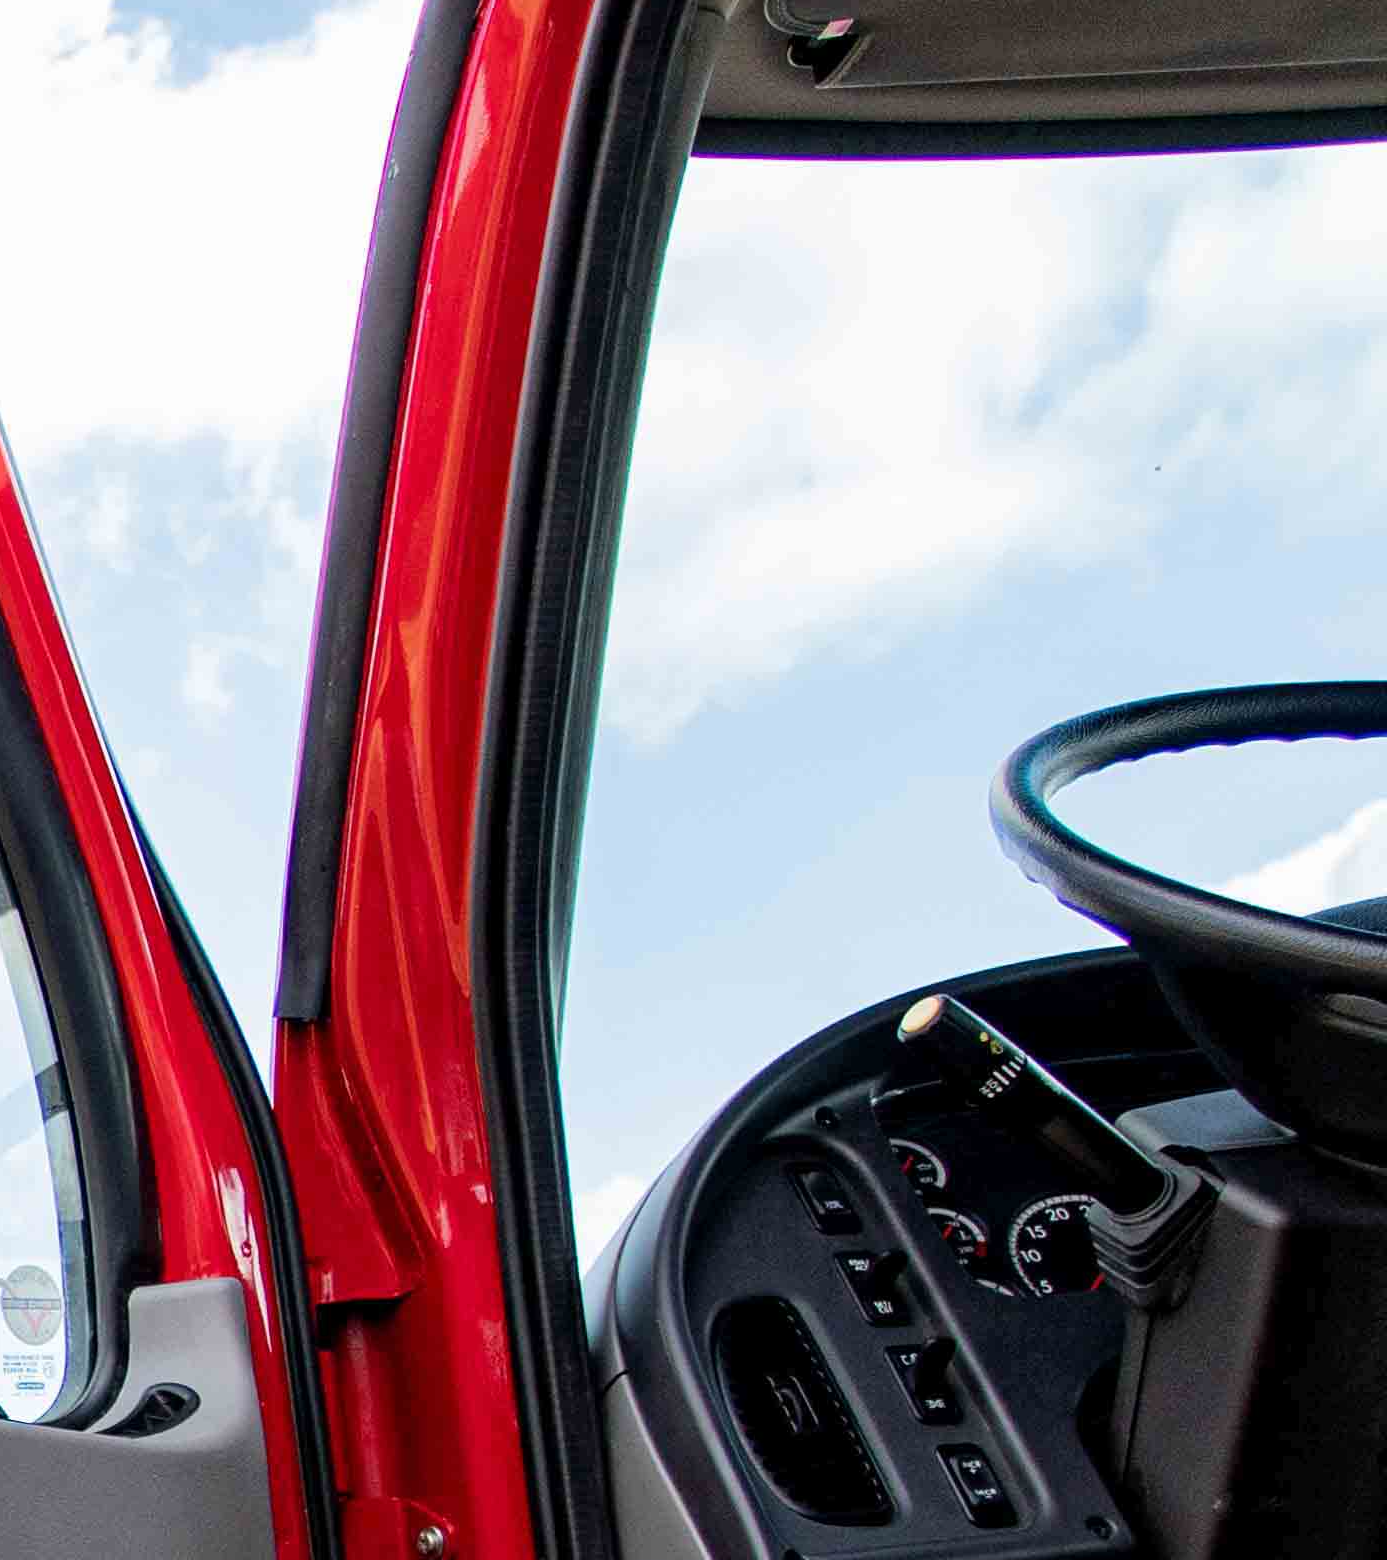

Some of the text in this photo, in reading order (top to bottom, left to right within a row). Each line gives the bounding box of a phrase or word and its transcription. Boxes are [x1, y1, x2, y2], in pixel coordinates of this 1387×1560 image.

[1045, 1207, 1070, 1221] 20
[1026, 1224, 1047, 1240] 15
[1020, 1248, 1042, 1263] 10
[1040, 1279, 1053, 1294] 5
